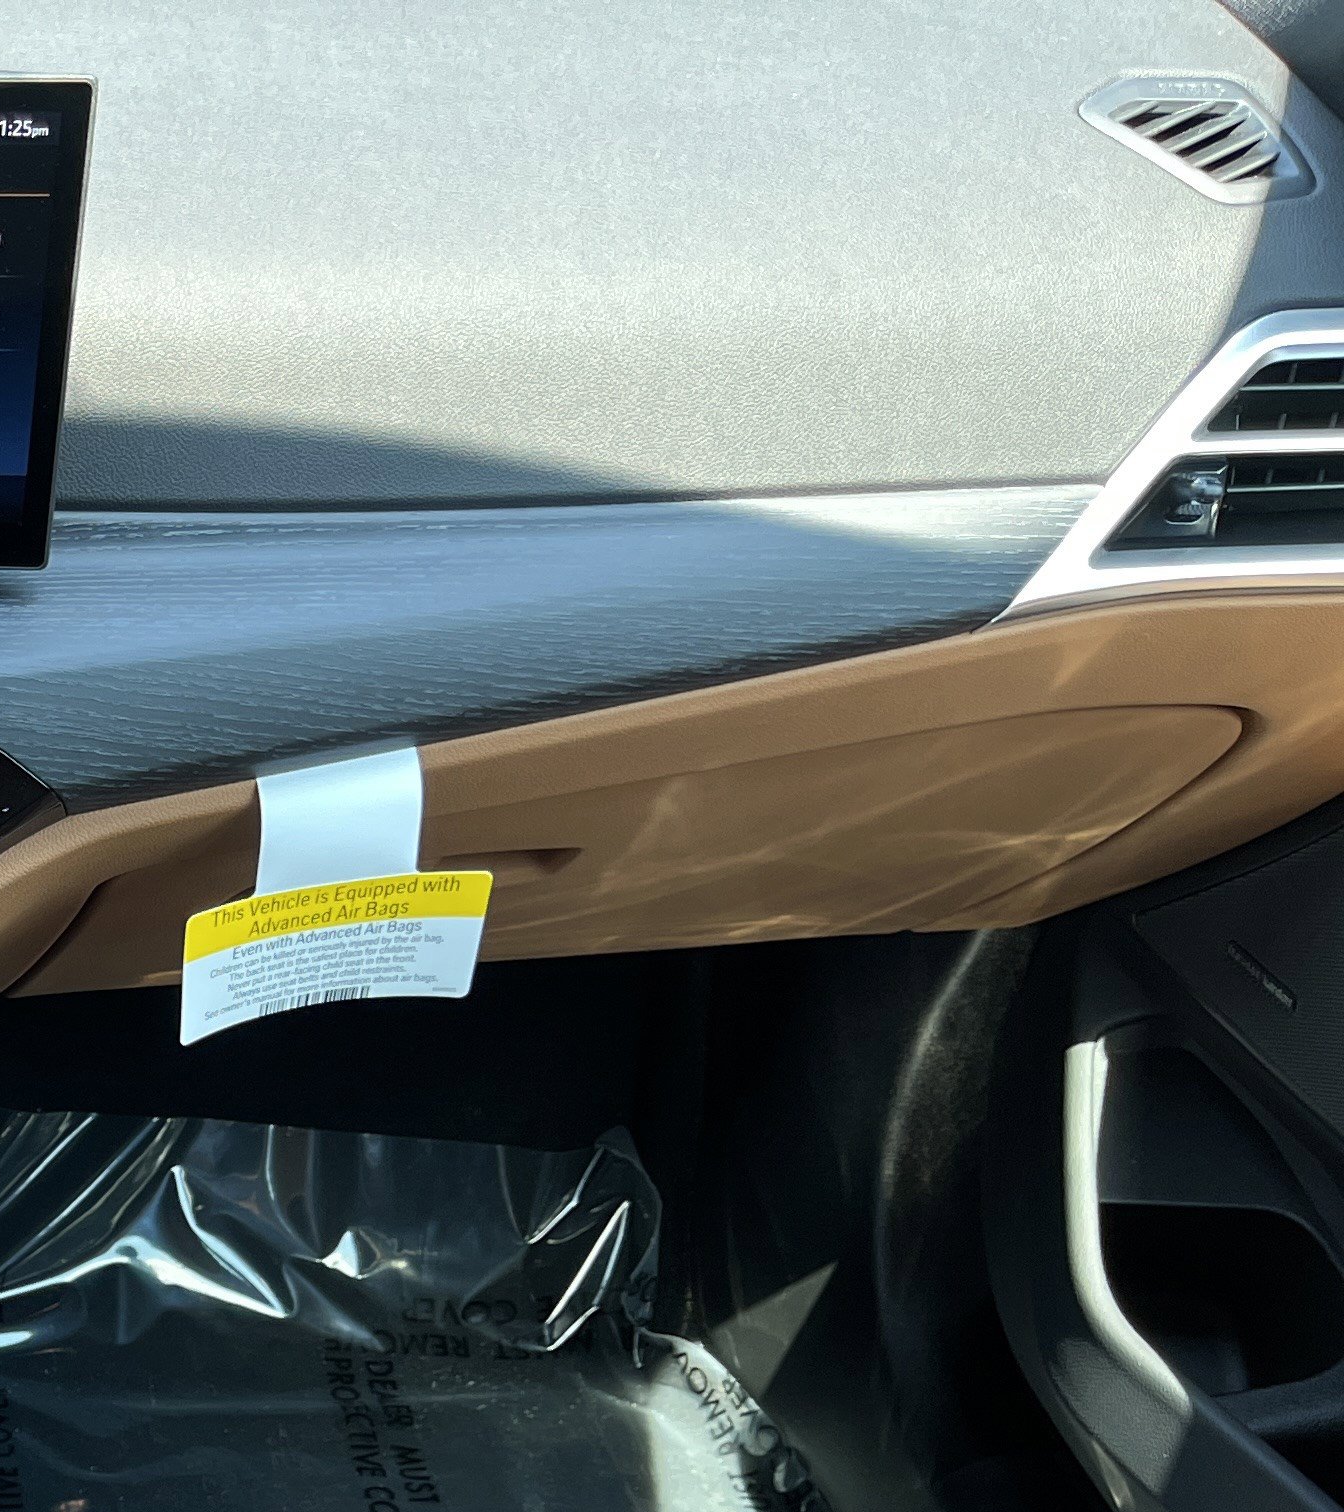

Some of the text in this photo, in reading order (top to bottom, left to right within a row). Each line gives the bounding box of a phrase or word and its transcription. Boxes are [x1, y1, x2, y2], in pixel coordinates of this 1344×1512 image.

[212, 876, 461, 928] This Vehicle is Equipped with
[248, 901, 409, 938] Advanced Air Bags
[232, 920, 423, 960] Even with Advanced Air Bags
[390, 1445, 441, 1505] MUST
